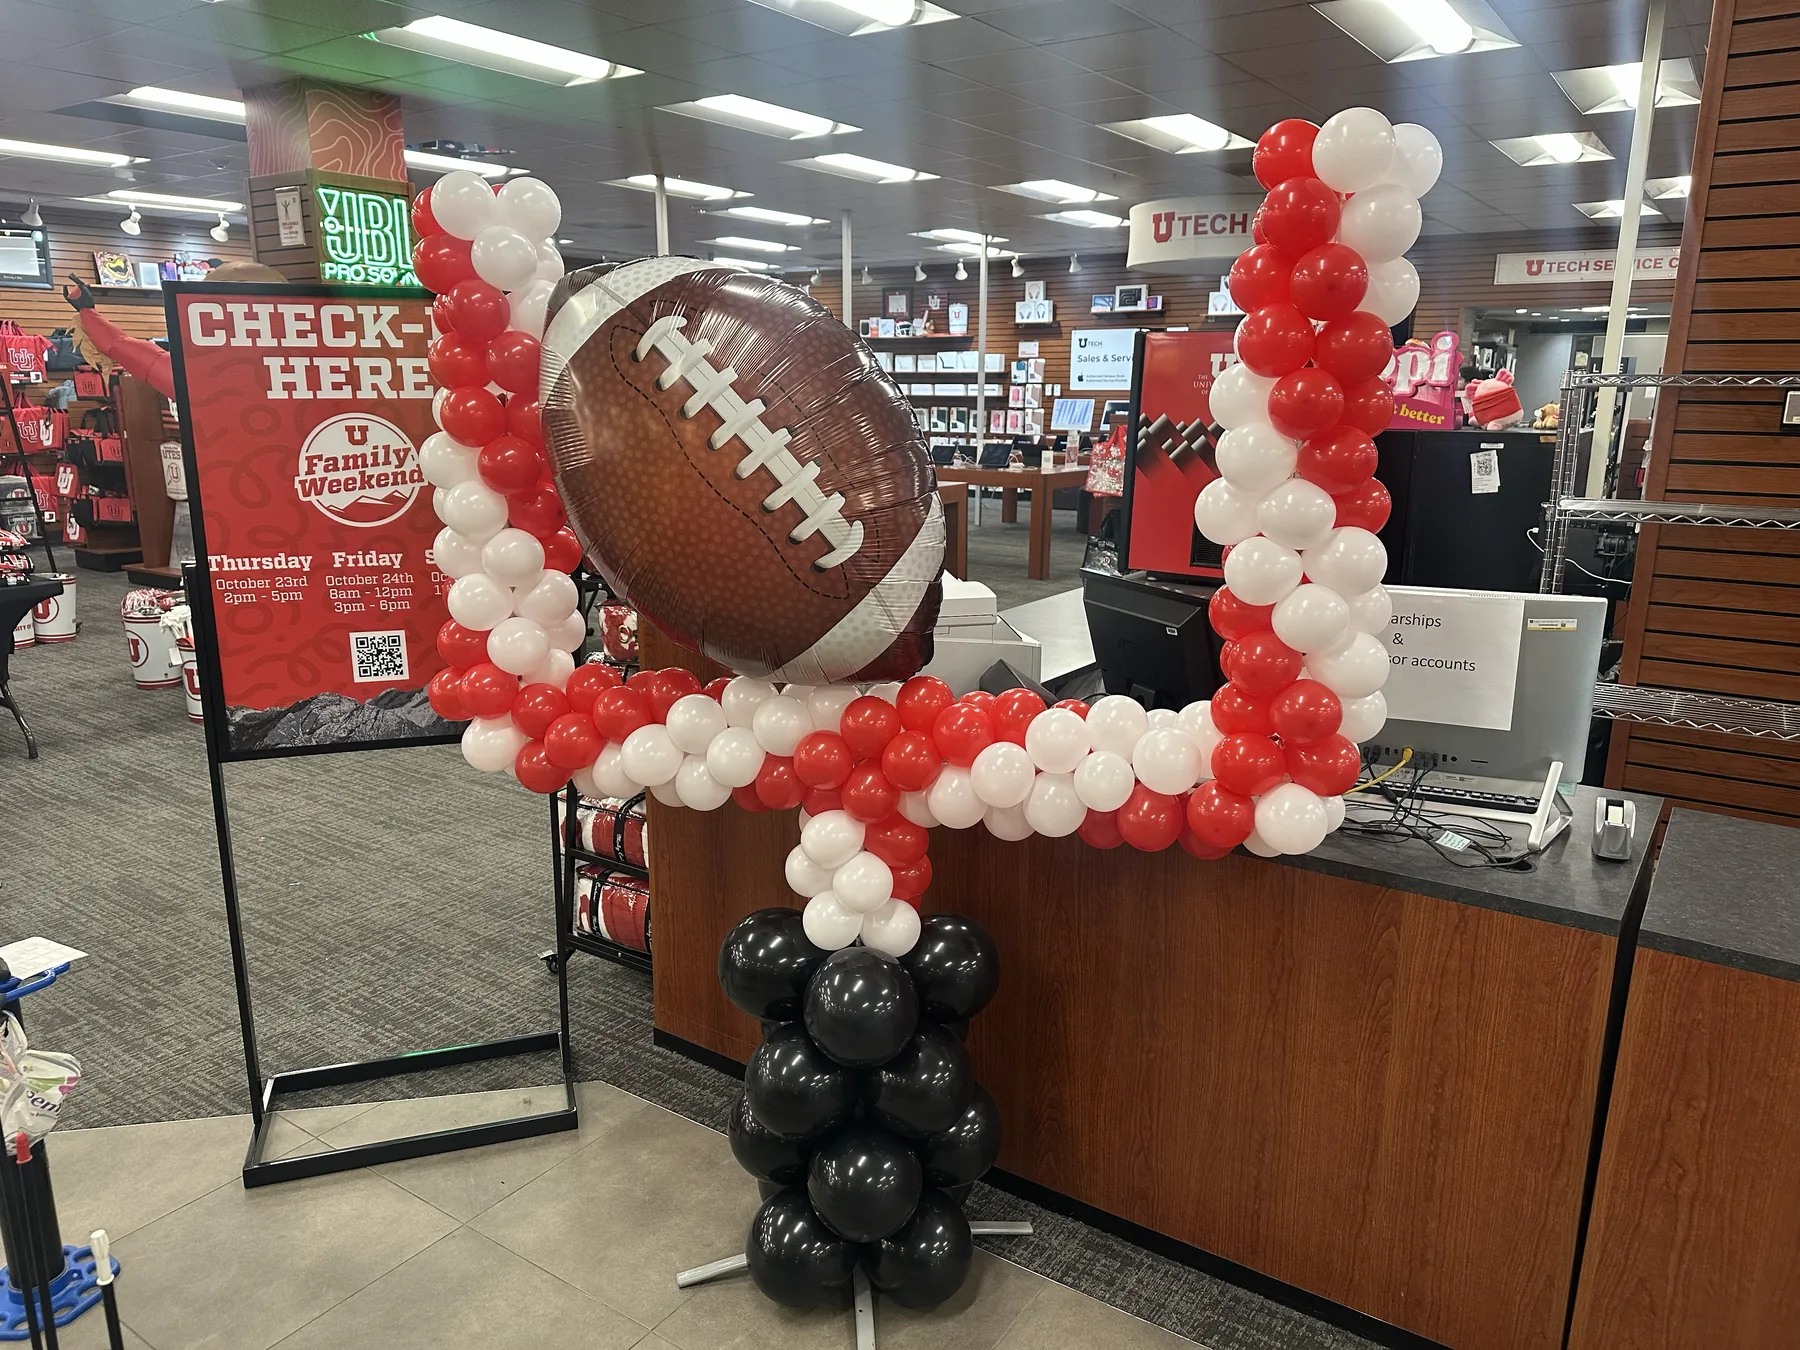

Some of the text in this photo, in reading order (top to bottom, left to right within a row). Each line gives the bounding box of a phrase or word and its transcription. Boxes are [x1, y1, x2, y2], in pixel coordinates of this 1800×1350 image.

[325, 262, 365, 281] PRO
[1593, 257, 1663, 272] SEICE
[1077, 354, 1132, 363] Sales & Serv
[263, 357, 434, 399] HERE
[1400, 404, 1445, 425] better
[162, 449, 181, 460] UTES
[305, 444, 411, 476] Family
[299, 463, 425, 498] Weekend
[208, 553, 312, 571] Thursday
[332, 551, 403, 568] Friday
[216, 576, 308, 590] October 23rd
[325, 572, 414, 586] October 24th
[224, 592, 257, 605] 2pm
[271, 590, 303, 603] 5pm
[329, 588, 361, 599] 8am
[374, 586, 413, 599] 12pm
[334, 601, 366, 614] 3pm
[380, 599, 411, 612] 6pm
[1388, 613, 1442, 629] arships
[1392, 632, 1404, 645] &
[1411, 657, 1476, 672] accounts
